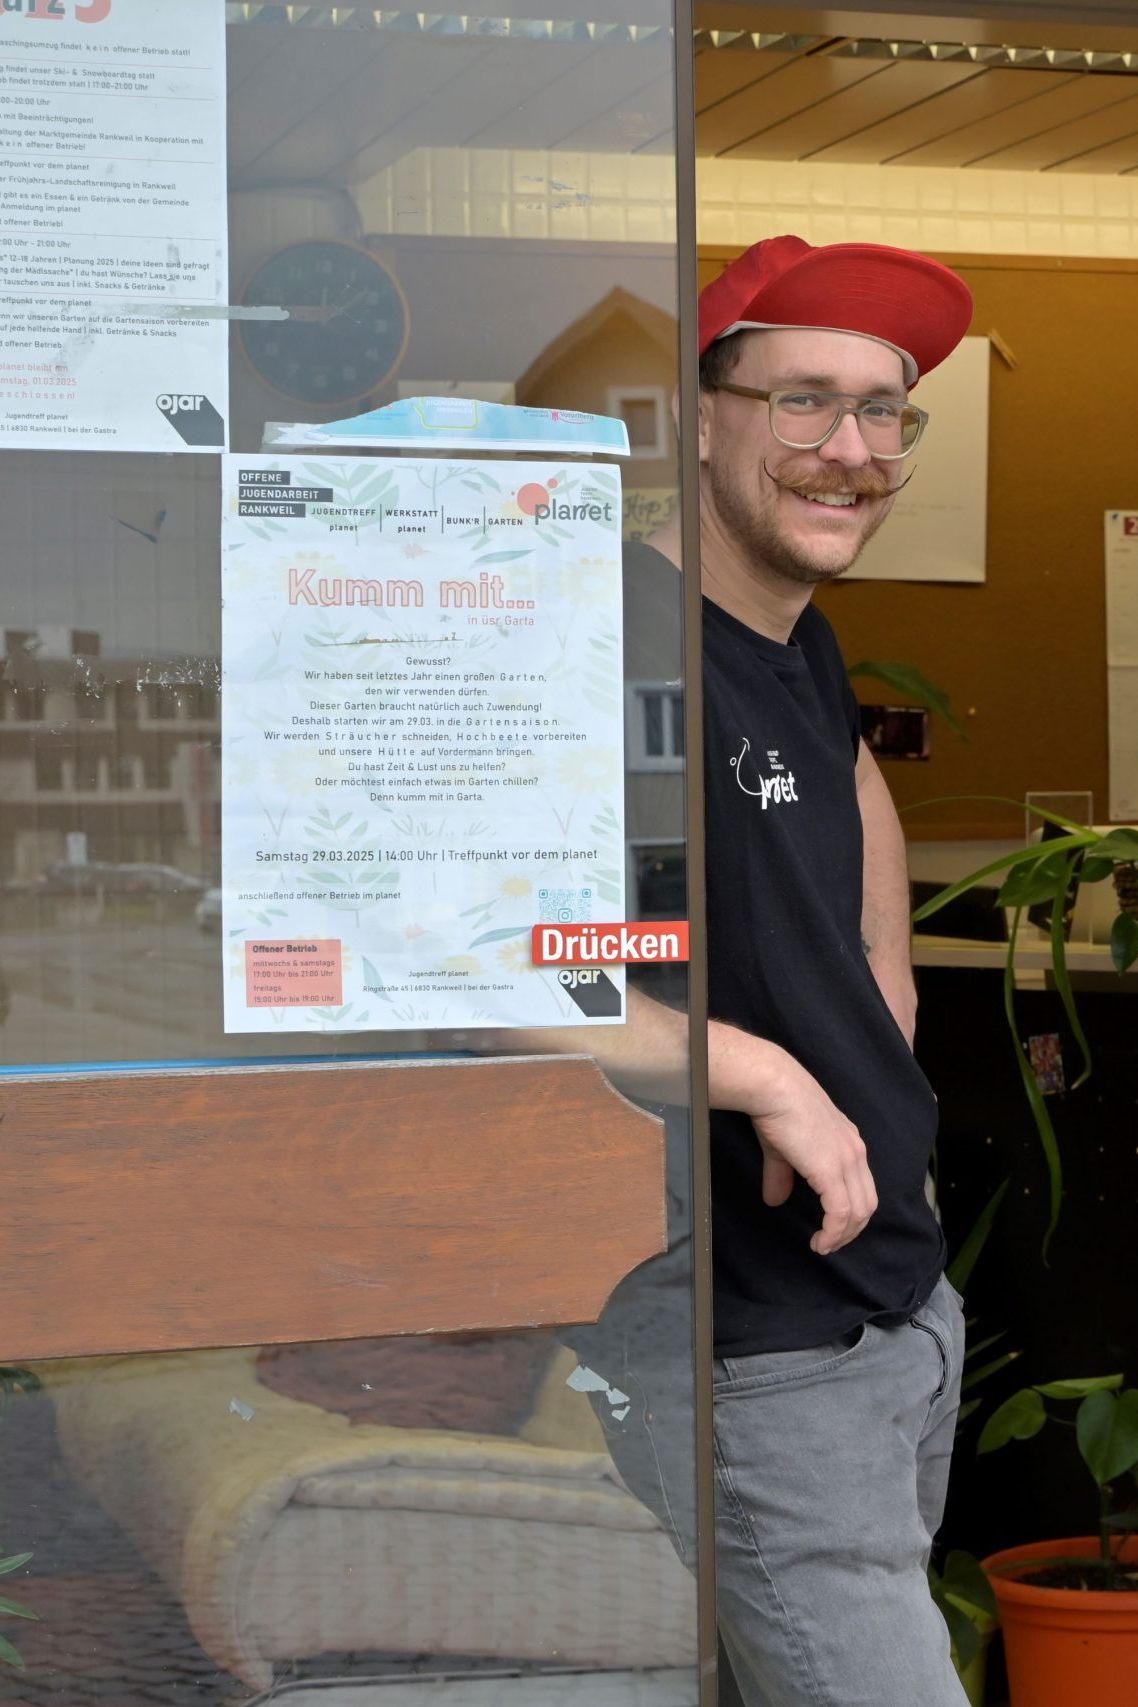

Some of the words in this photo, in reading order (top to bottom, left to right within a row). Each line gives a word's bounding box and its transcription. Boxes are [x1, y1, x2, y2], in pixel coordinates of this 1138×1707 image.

[156, 395, 204, 415] ojar
[241, 473, 282, 482] OFFENE
[241, 489, 319, 499] JUGENDARBEIT
[241, 505, 295, 515] RANKWEIL
[535, 499, 612, 525] planet
[312, 508, 376, 517] JUGENDTREFF
[385, 510, 438, 518] WERKSTATT
[447, 517, 480, 525] BUNK'R
[330, 524, 358, 532] planet
[398, 525, 426, 533] planet
[289, 569, 424, 608] Kumm
[440, 572, 535, 609] mit...
[468, 614, 479, 624] in
[481, 615, 501, 626] üsr
[504, 614, 535, 626] Garta
[406, 656, 451, 665] Gewusst?
[305, 671, 322, 680] Wir
[324, 671, 353, 680] haben
[356, 672, 373, 680] seit
[376, 672, 408, 680] letztes
[411, 672, 432, 680] Jahr
[435, 672, 460, 680] einen
[463, 673, 494, 683] großen
[500, 673, 547, 682] Garten,
[365, 687, 382, 695] den
[385, 687, 401, 695] wir
[404, 688, 456, 696] verwenden
[458, 687, 489, 696] dürfen.
[310, 701, 341, 711] Dieser
[344, 701, 376, 712] Garten
[379, 701, 416, 711] braucht
[418, 702, 460, 711] natürlich
[463, 702, 484, 711] auch
[487, 702, 542, 713] Zuwendung!
[292, 716, 331, 726] Deshalb
[334, 717, 369, 727] starten
[372, 717, 387, 727] wir
[407, 717, 434, 728] 29.03.
[437, 717, 444, 726] in
[447, 717, 461, 726] die
[466, 718, 560, 726] Gartensaison.
[264, 730, 281, 740] Wir
[284, 730, 319, 740] werden
[326, 732, 397, 741] Sträucher
[402, 732, 452, 742] schneiden,
[457, 732, 528, 742] Hochbeete
[533, 732, 586, 741] vorbereiten
[319, 747, 336, 757] und
[378, 747, 416, 756] Hütte
[421, 747, 435, 756] auf
[438, 747, 494, 757] Vordermann
[496, 747, 535, 758] bringen.
[348, 762, 361, 771] Du
[364, 762, 385, 772] hast
[387, 761, 405, 771] Zeit
[418, 762, 438, 771] Lust
[440, 763, 457, 771] uns
[459, 763, 469, 771] zu
[472, 762, 506, 771] helfen?
[315, 777, 338, 786] Oder
[341, 777, 385, 786] möchtest
[388, 777, 422, 787] einfach
[425, 776, 452, 786] etwas
[455, 776, 465, 786] im
[468, 777, 500, 786] Garten
[503, 776, 538, 786] chillen?
[370, 793, 394, 801] Denn
[397, 793, 427, 801] kumm
[430, 792, 443, 801] mit
[447, 793, 454, 801] in
[457, 792, 485, 801] Garta.
[256, 851, 308, 864] Samstag
[312, 850, 374, 863] 29.03.2025
[385, 850, 413, 861] 14:00
[417, 850, 438, 862] Uhr
[448, 850, 508, 862] Treffpunkt
[511, 852, 531, 860] vor
[534, 849, 559, 859] dem
[562, 849, 598, 861] planet
[238, 891, 295, 901] anschließend
[297, 892, 327, 900] offener
[329, 890, 360, 899] Betrieb
[362, 891, 373, 899] im
[375, 891, 401, 901] planet
[253, 945, 284, 953] Offener
[542, 928, 678, 961] Drücken
[446, 969, 469, 978] planet
[558, 969, 600, 988] ojar
